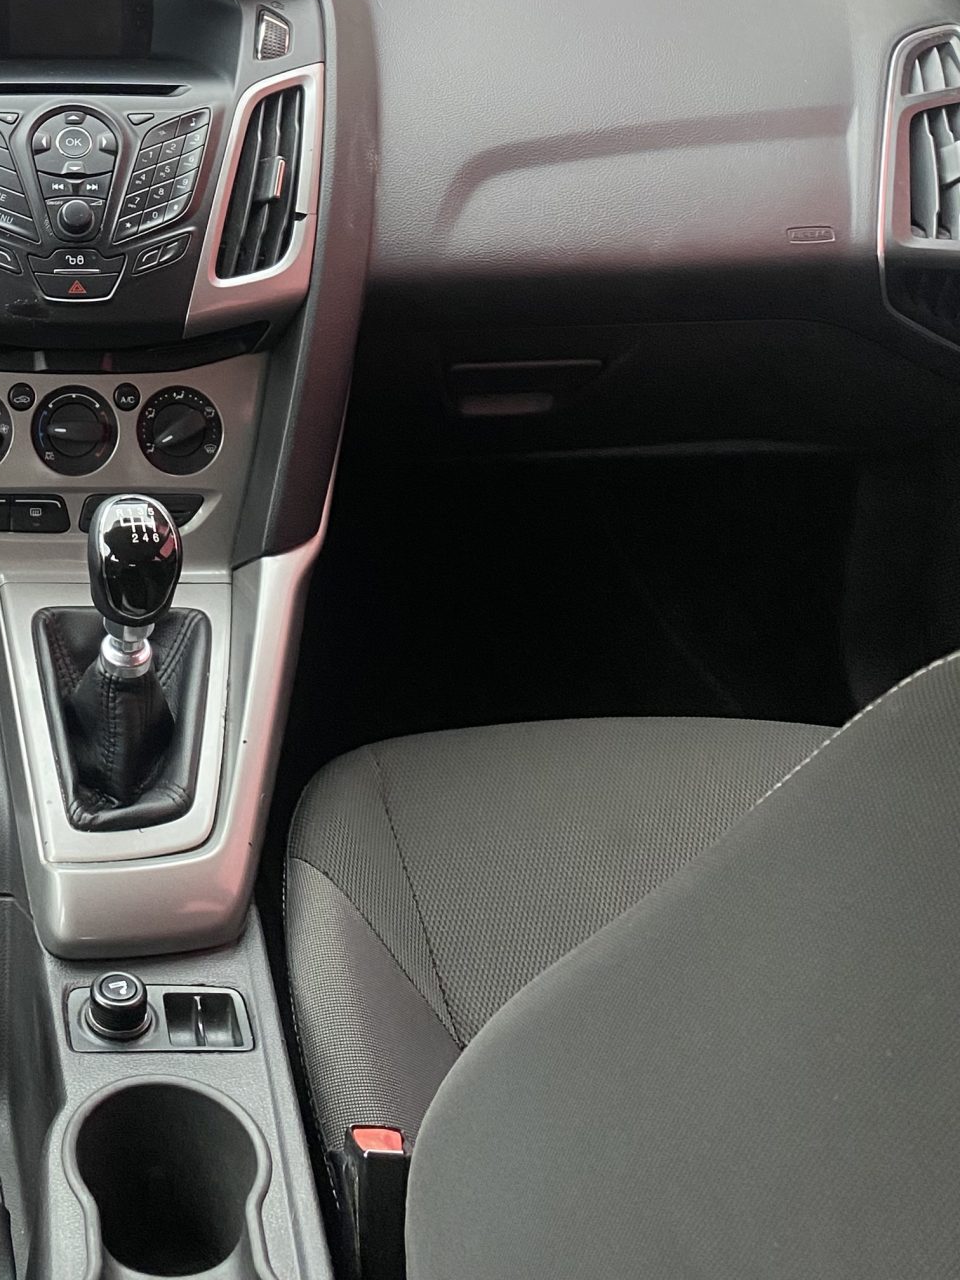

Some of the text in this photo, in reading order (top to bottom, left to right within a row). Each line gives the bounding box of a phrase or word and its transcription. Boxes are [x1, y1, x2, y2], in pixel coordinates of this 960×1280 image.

[65, 137, 82, 147] OK
[170, 143, 177, 151] 2
[164, 165, 171, 173] 5
[134, 178, 189, 204] 7 8 9
[151, 211, 159, 219] 0
[120, 396, 135, 404] A/C
[147, 507, 155, 516] 5
[131, 533, 160, 543] 2 4 6
